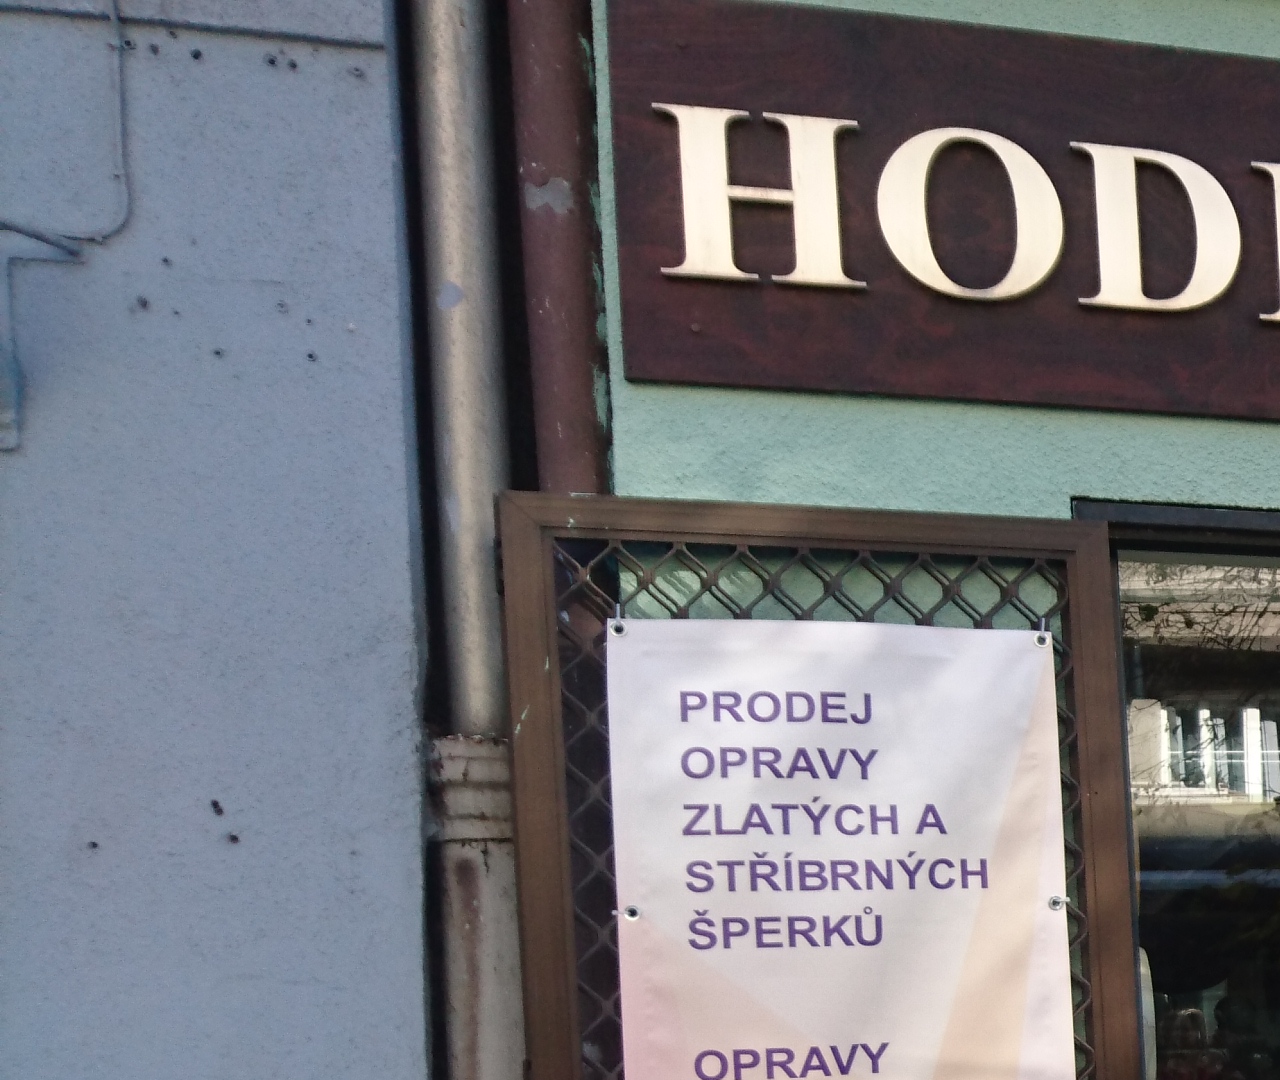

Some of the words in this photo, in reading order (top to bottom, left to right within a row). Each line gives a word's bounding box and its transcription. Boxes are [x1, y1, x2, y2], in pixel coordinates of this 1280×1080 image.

[680, 690, 873, 724] PRODEJ
[681, 747, 879, 780] OPRAVY
[682, 796, 899, 837] ZLATÝCH
[915, 803, 947, 835] A
[685, 850, 989, 894] STŘÍBRNÝCH
[688, 906, 884, 950] ŠPERKŮ
